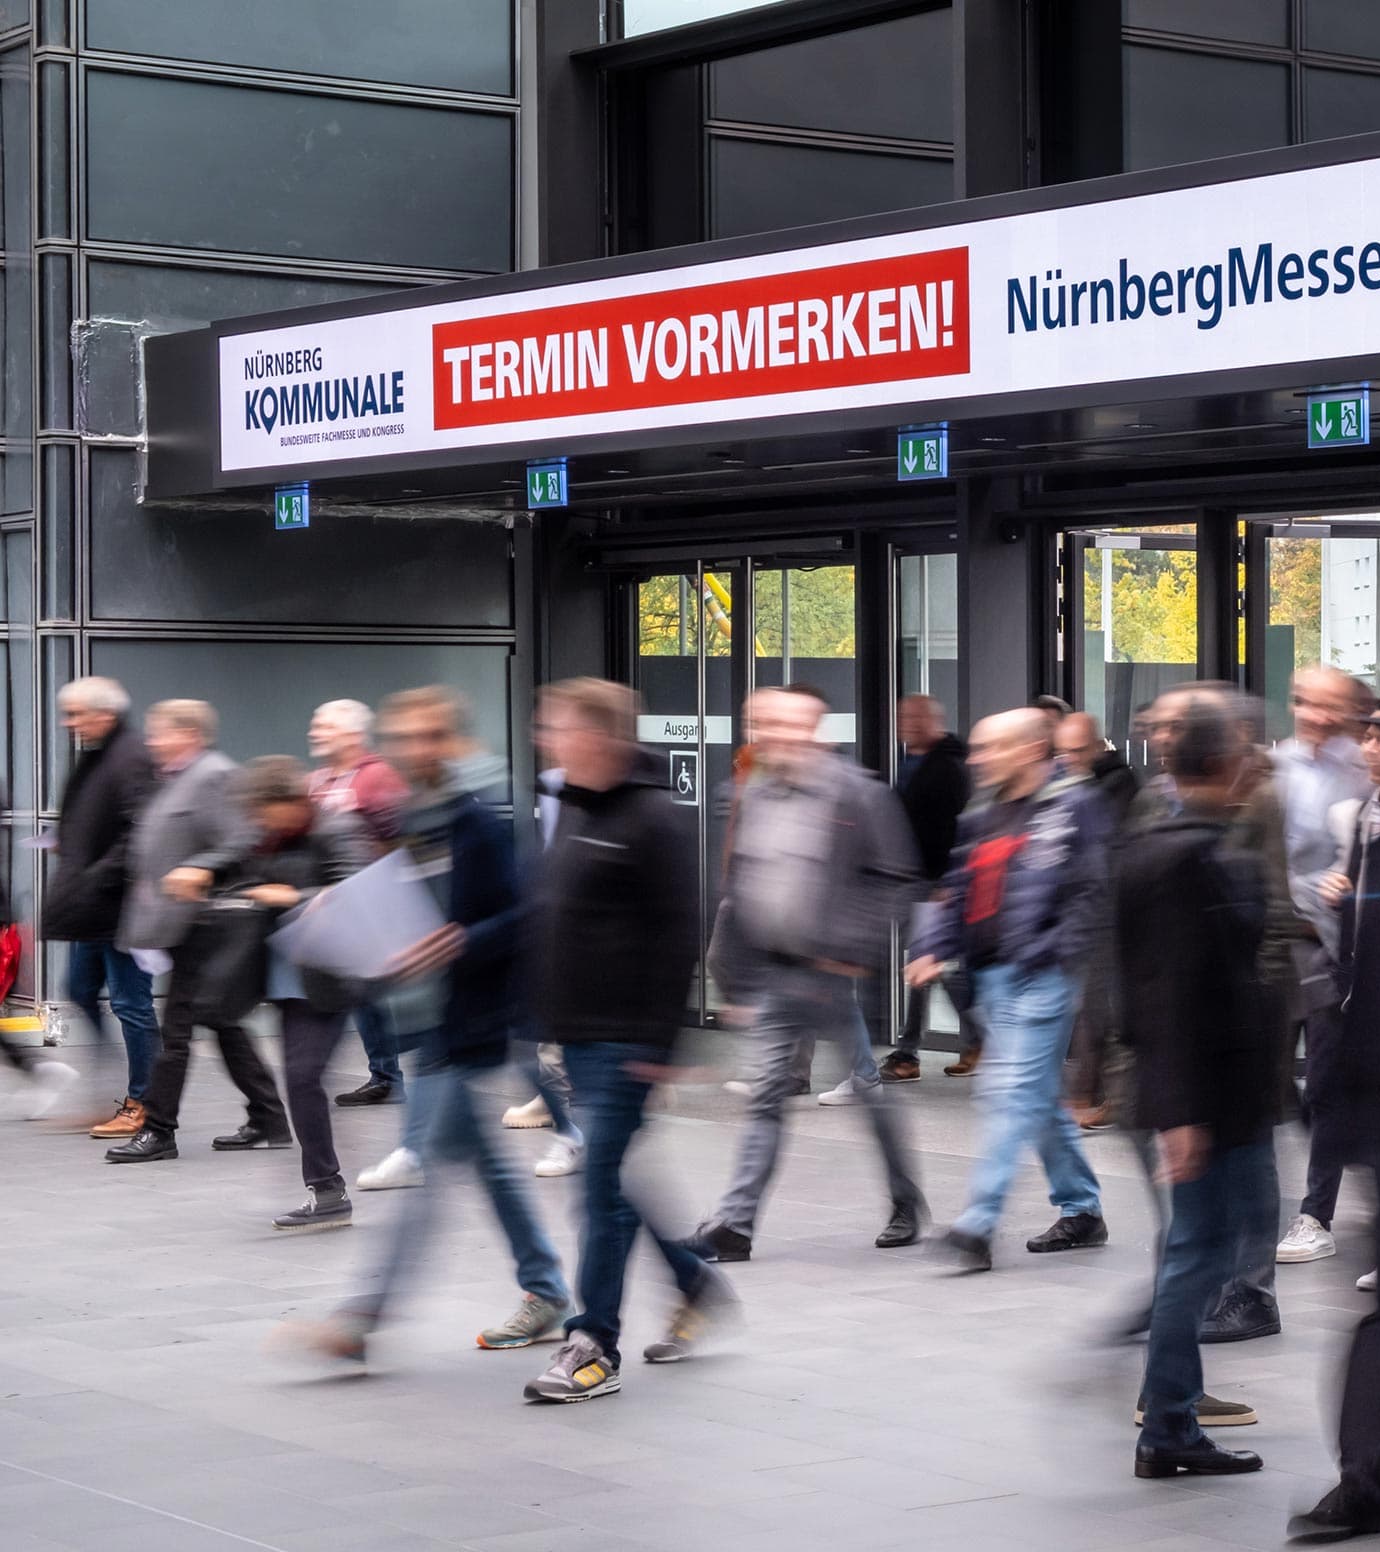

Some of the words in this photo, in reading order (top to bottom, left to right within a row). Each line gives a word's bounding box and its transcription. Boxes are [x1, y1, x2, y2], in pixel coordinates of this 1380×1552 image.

[244, 347, 322, 380] NÜRNBERG
[443, 327, 608, 404] TERMIN
[622, 279, 955, 384] VORMERKEN!
[245, 370, 404, 435] KOMMUNALE
[280, 433, 320, 447] BUNDESWEITE
[321, 429, 356, 442] FACHMESSE
[357, 427, 371, 438] UND
[372, 423, 405, 437] KONGRESS
